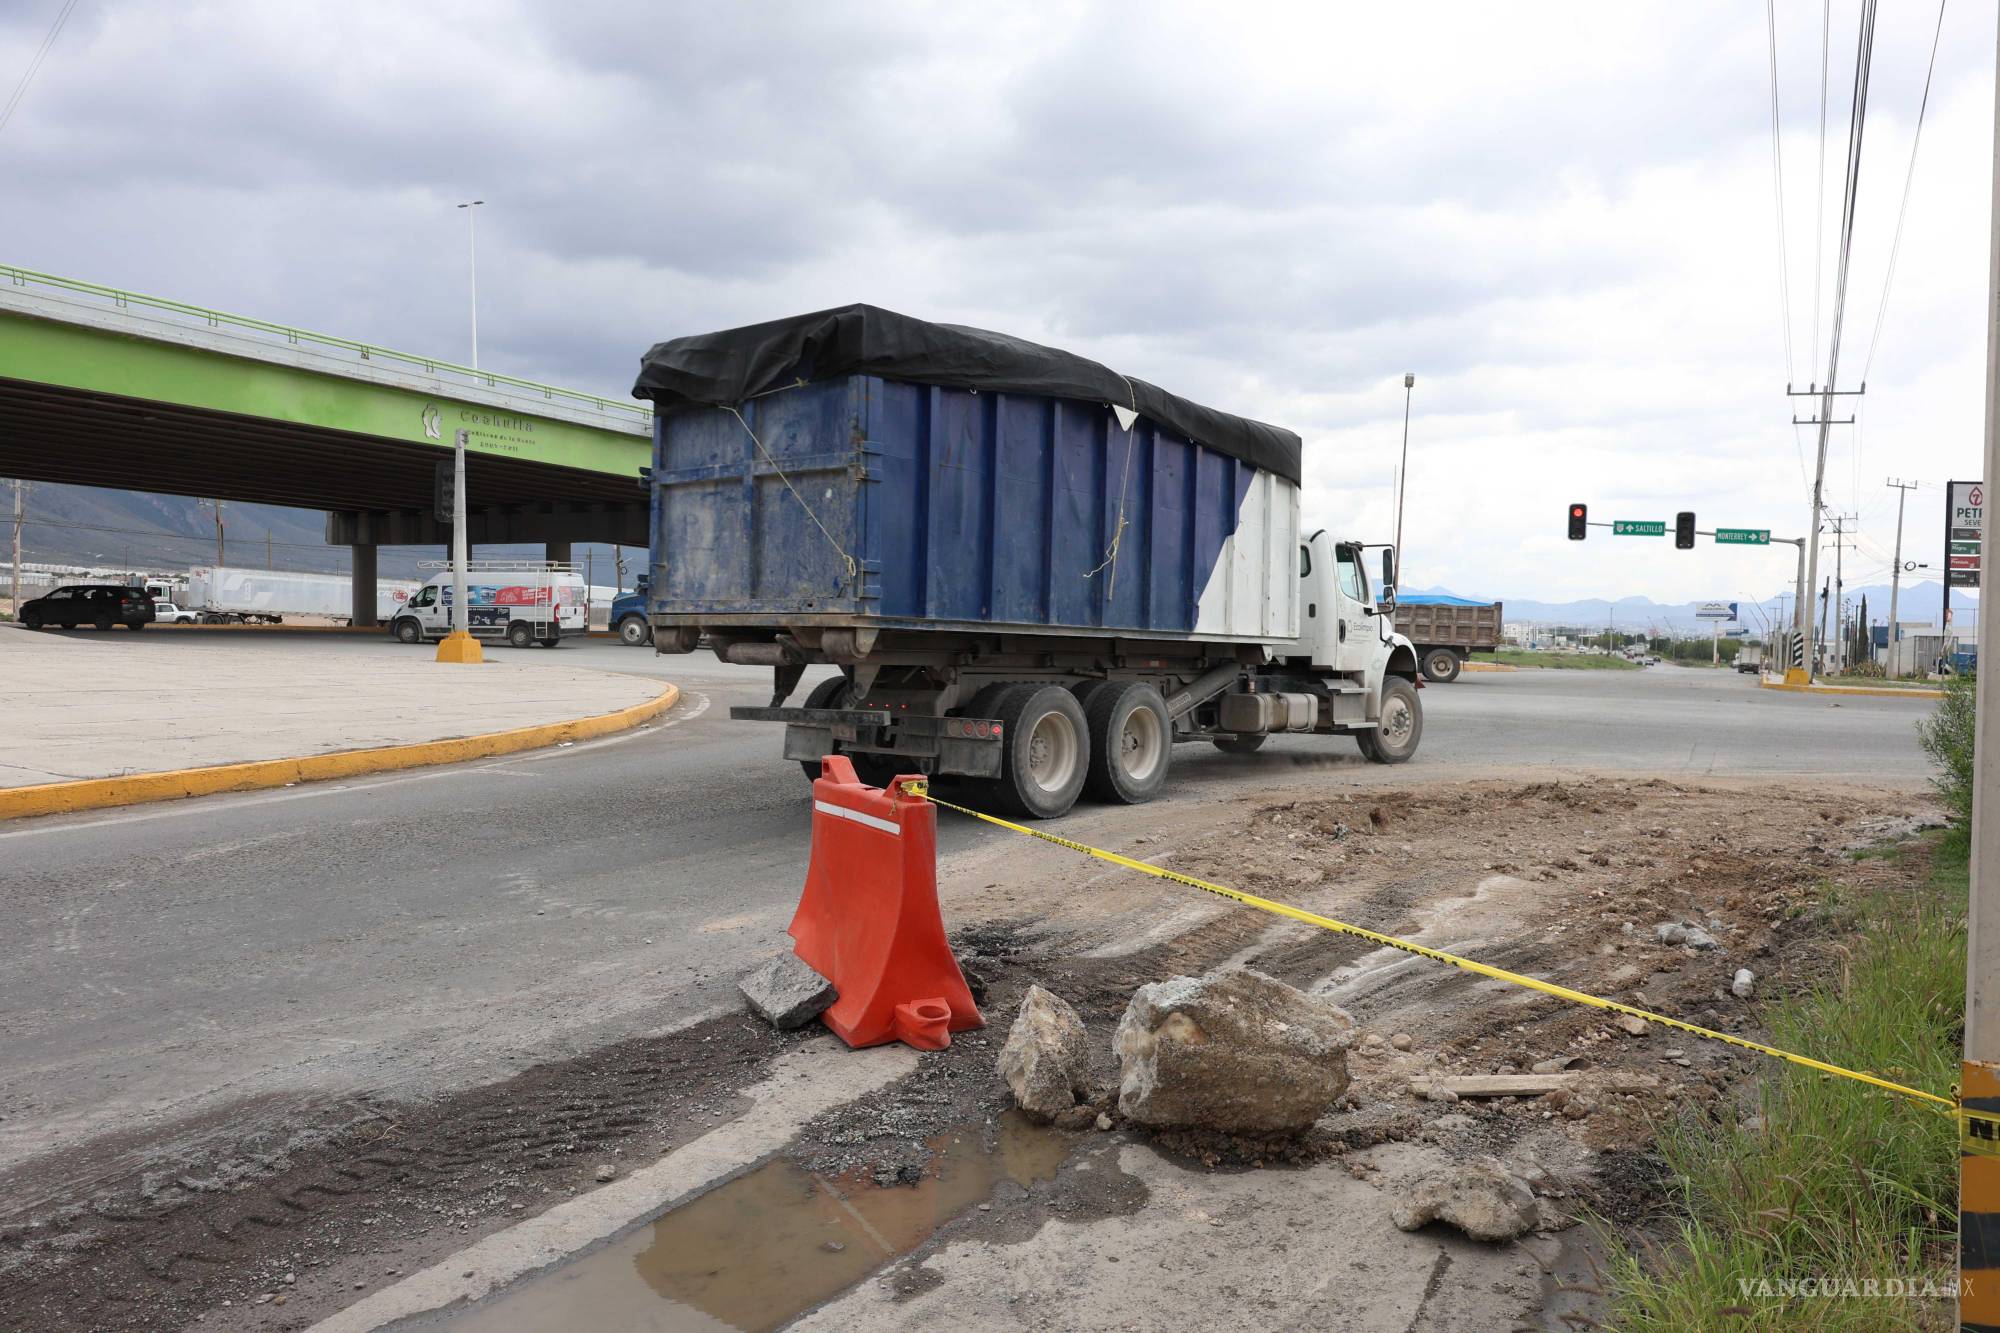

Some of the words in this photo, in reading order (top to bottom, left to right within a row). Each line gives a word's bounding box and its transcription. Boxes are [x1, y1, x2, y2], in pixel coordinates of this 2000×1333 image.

[459, 408, 535, 433] Coahuila
[1635, 524, 1663, 533] SALTILLO
[1717, 532, 1748, 541] MONTERREY
